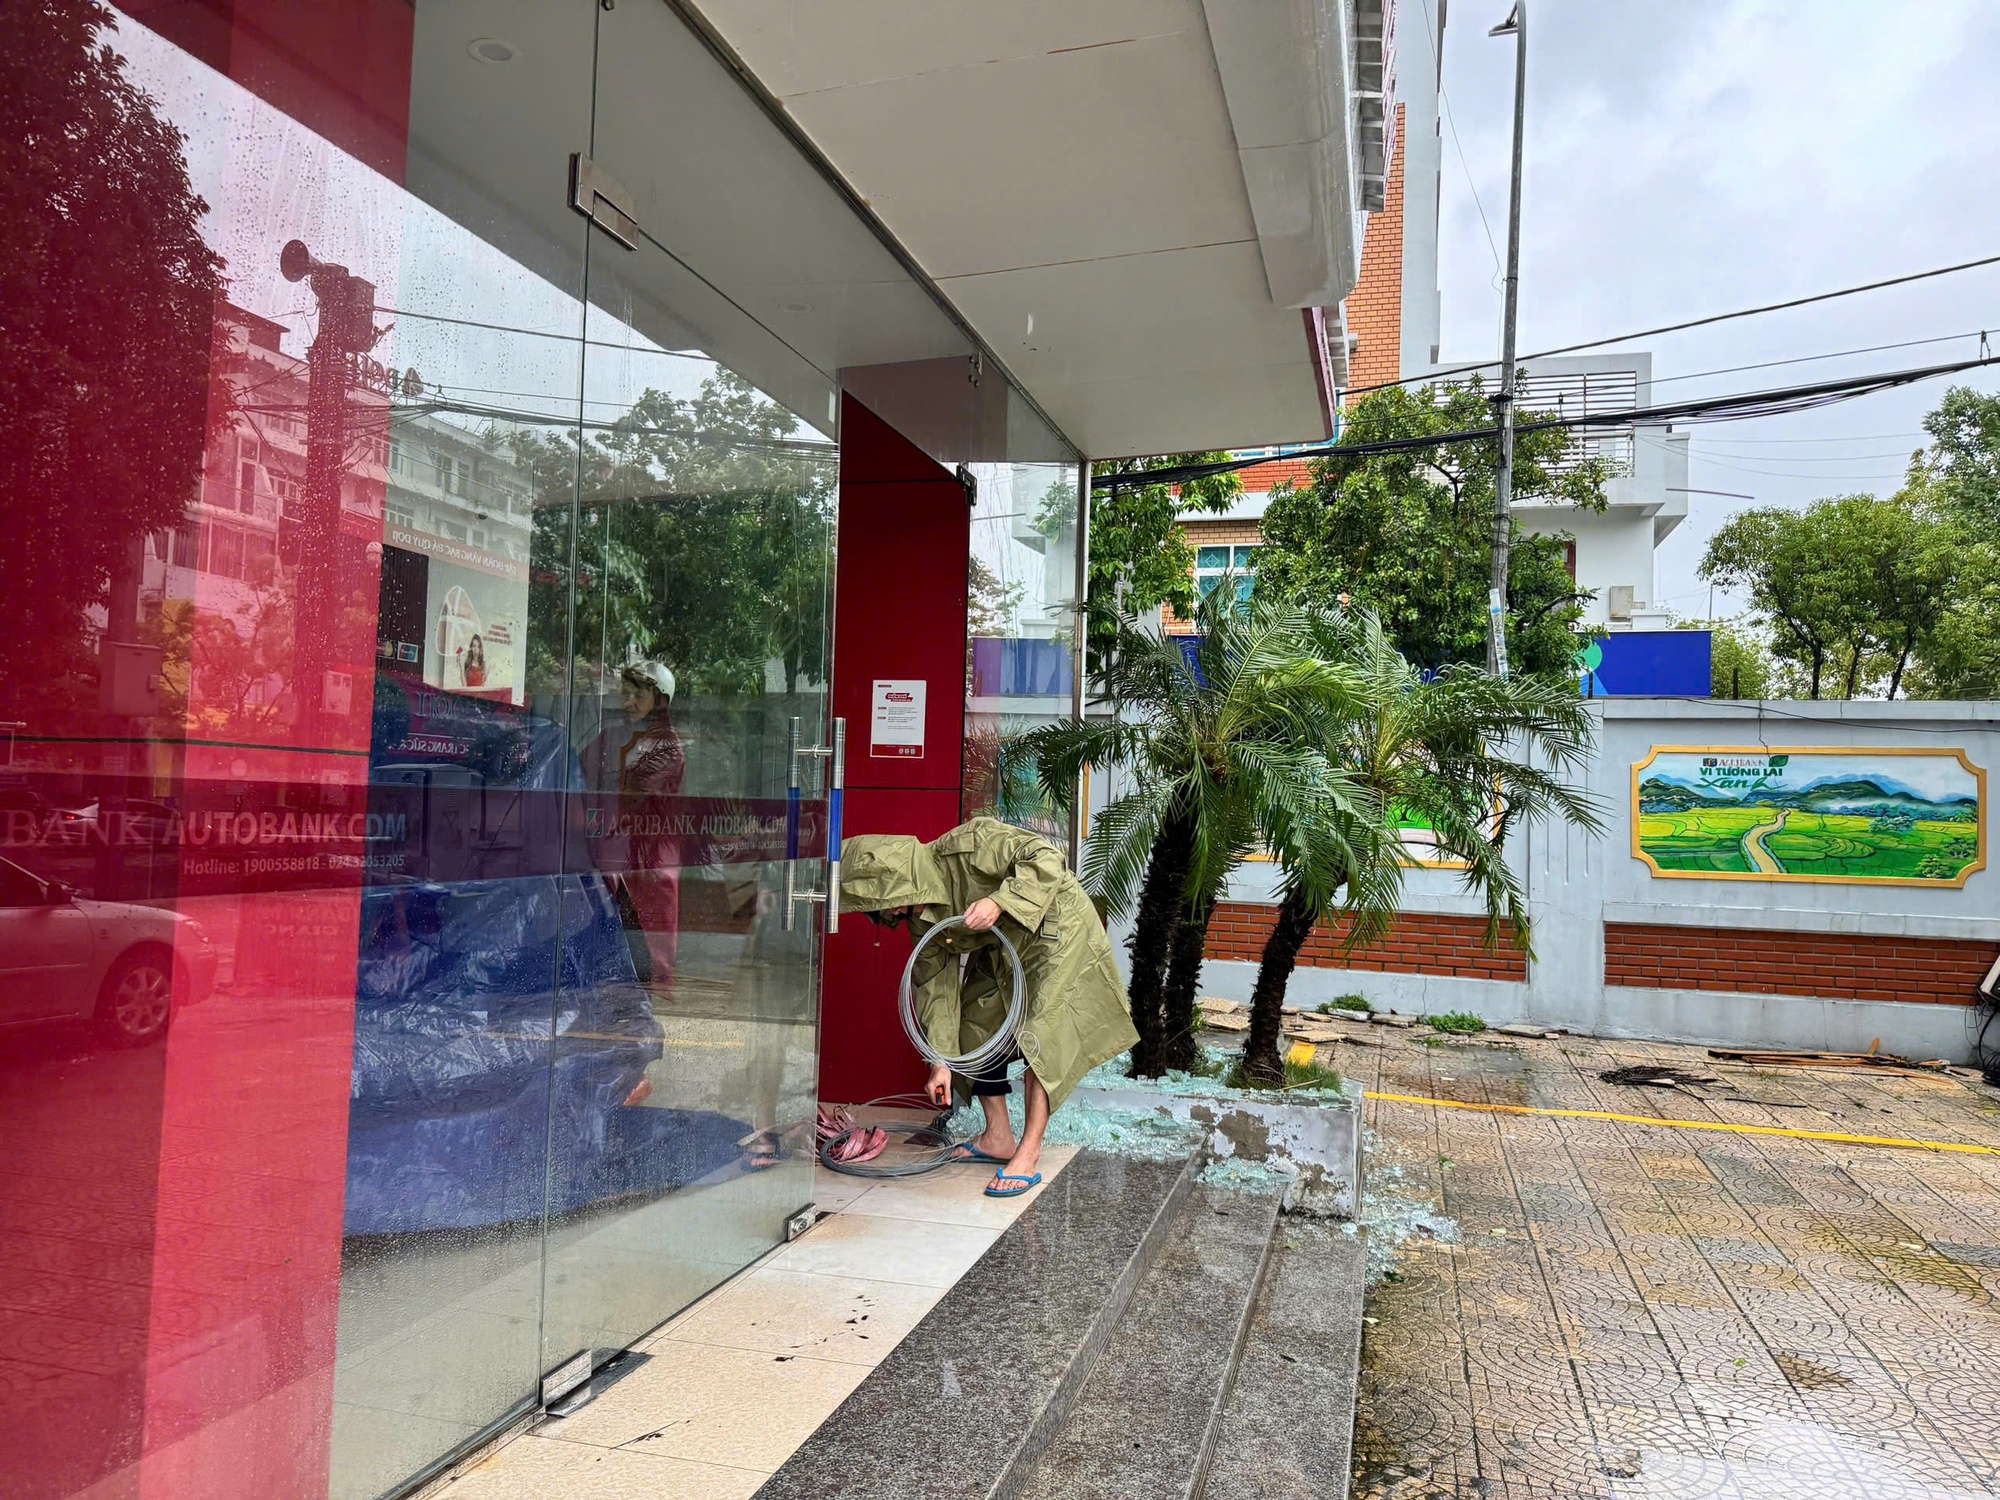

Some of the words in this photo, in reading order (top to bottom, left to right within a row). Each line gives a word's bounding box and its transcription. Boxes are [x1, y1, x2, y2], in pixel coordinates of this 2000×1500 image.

[1715, 766, 1760, 776] TƯƠNG
[1763, 768, 1783, 776] LAI
[0, 809, 148, 846] BANK
[162, 811, 343, 846] AUTOBANK
[349, 813, 406, 843] CDM
[606, 814, 697, 836] AGRIBANK
[183, 858, 240, 875] Hotline:
[244, 857, 320, 874] 1900558818
